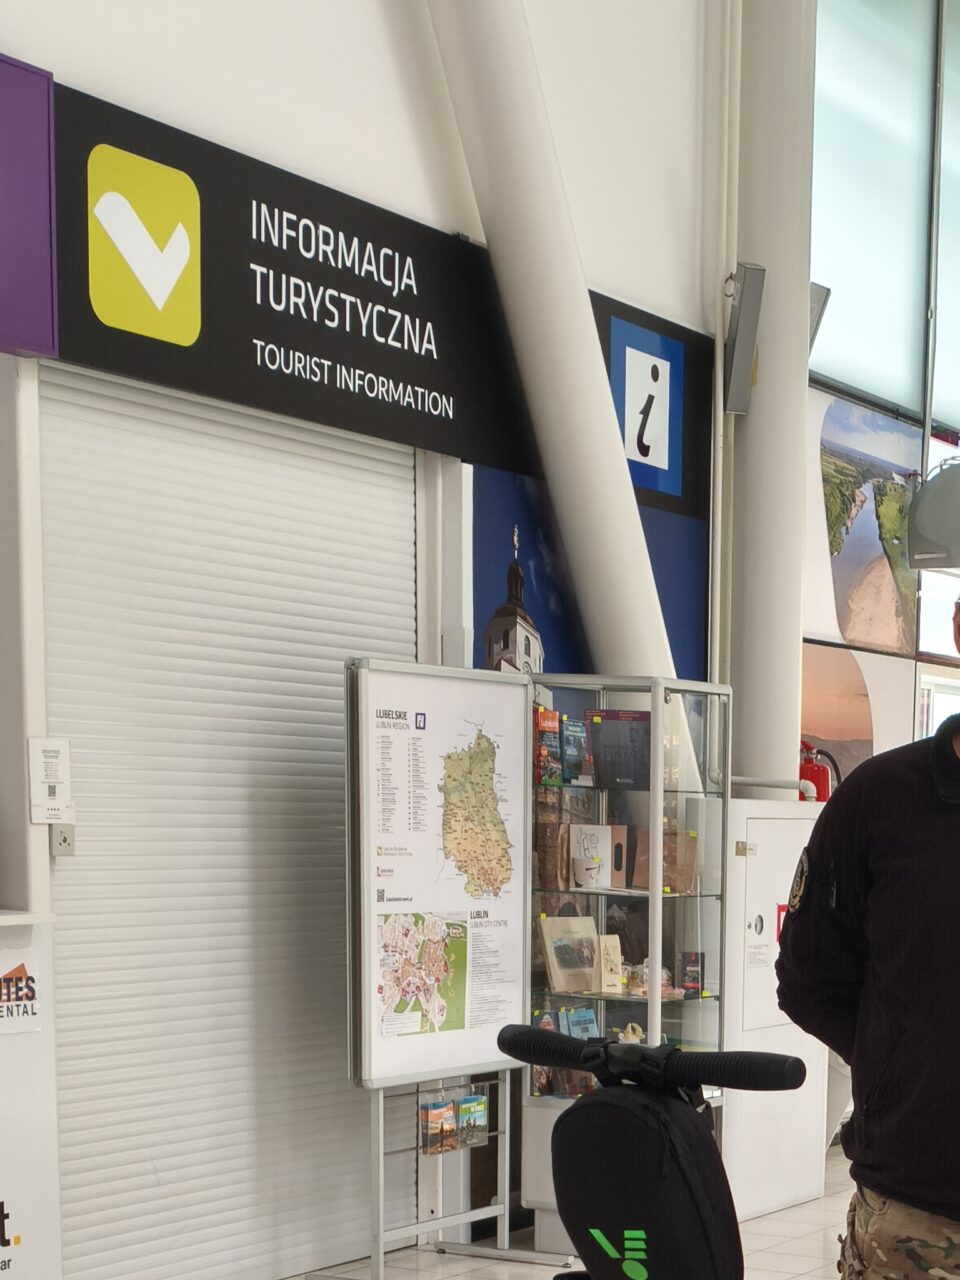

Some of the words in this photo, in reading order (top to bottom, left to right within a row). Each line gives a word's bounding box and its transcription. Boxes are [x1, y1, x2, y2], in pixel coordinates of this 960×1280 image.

[251, 200, 418, 298] INFORMACJA
[249, 263, 438, 360] TURYSTYCZNA
[252, 339, 331, 387] TOURIST
[335, 365, 454, 420] INFORMATION
[375, 709, 408, 721] LUBELSKIE
[470, 910, 489, 920] LUBLIN
[0, 976, 35, 1002] TES
